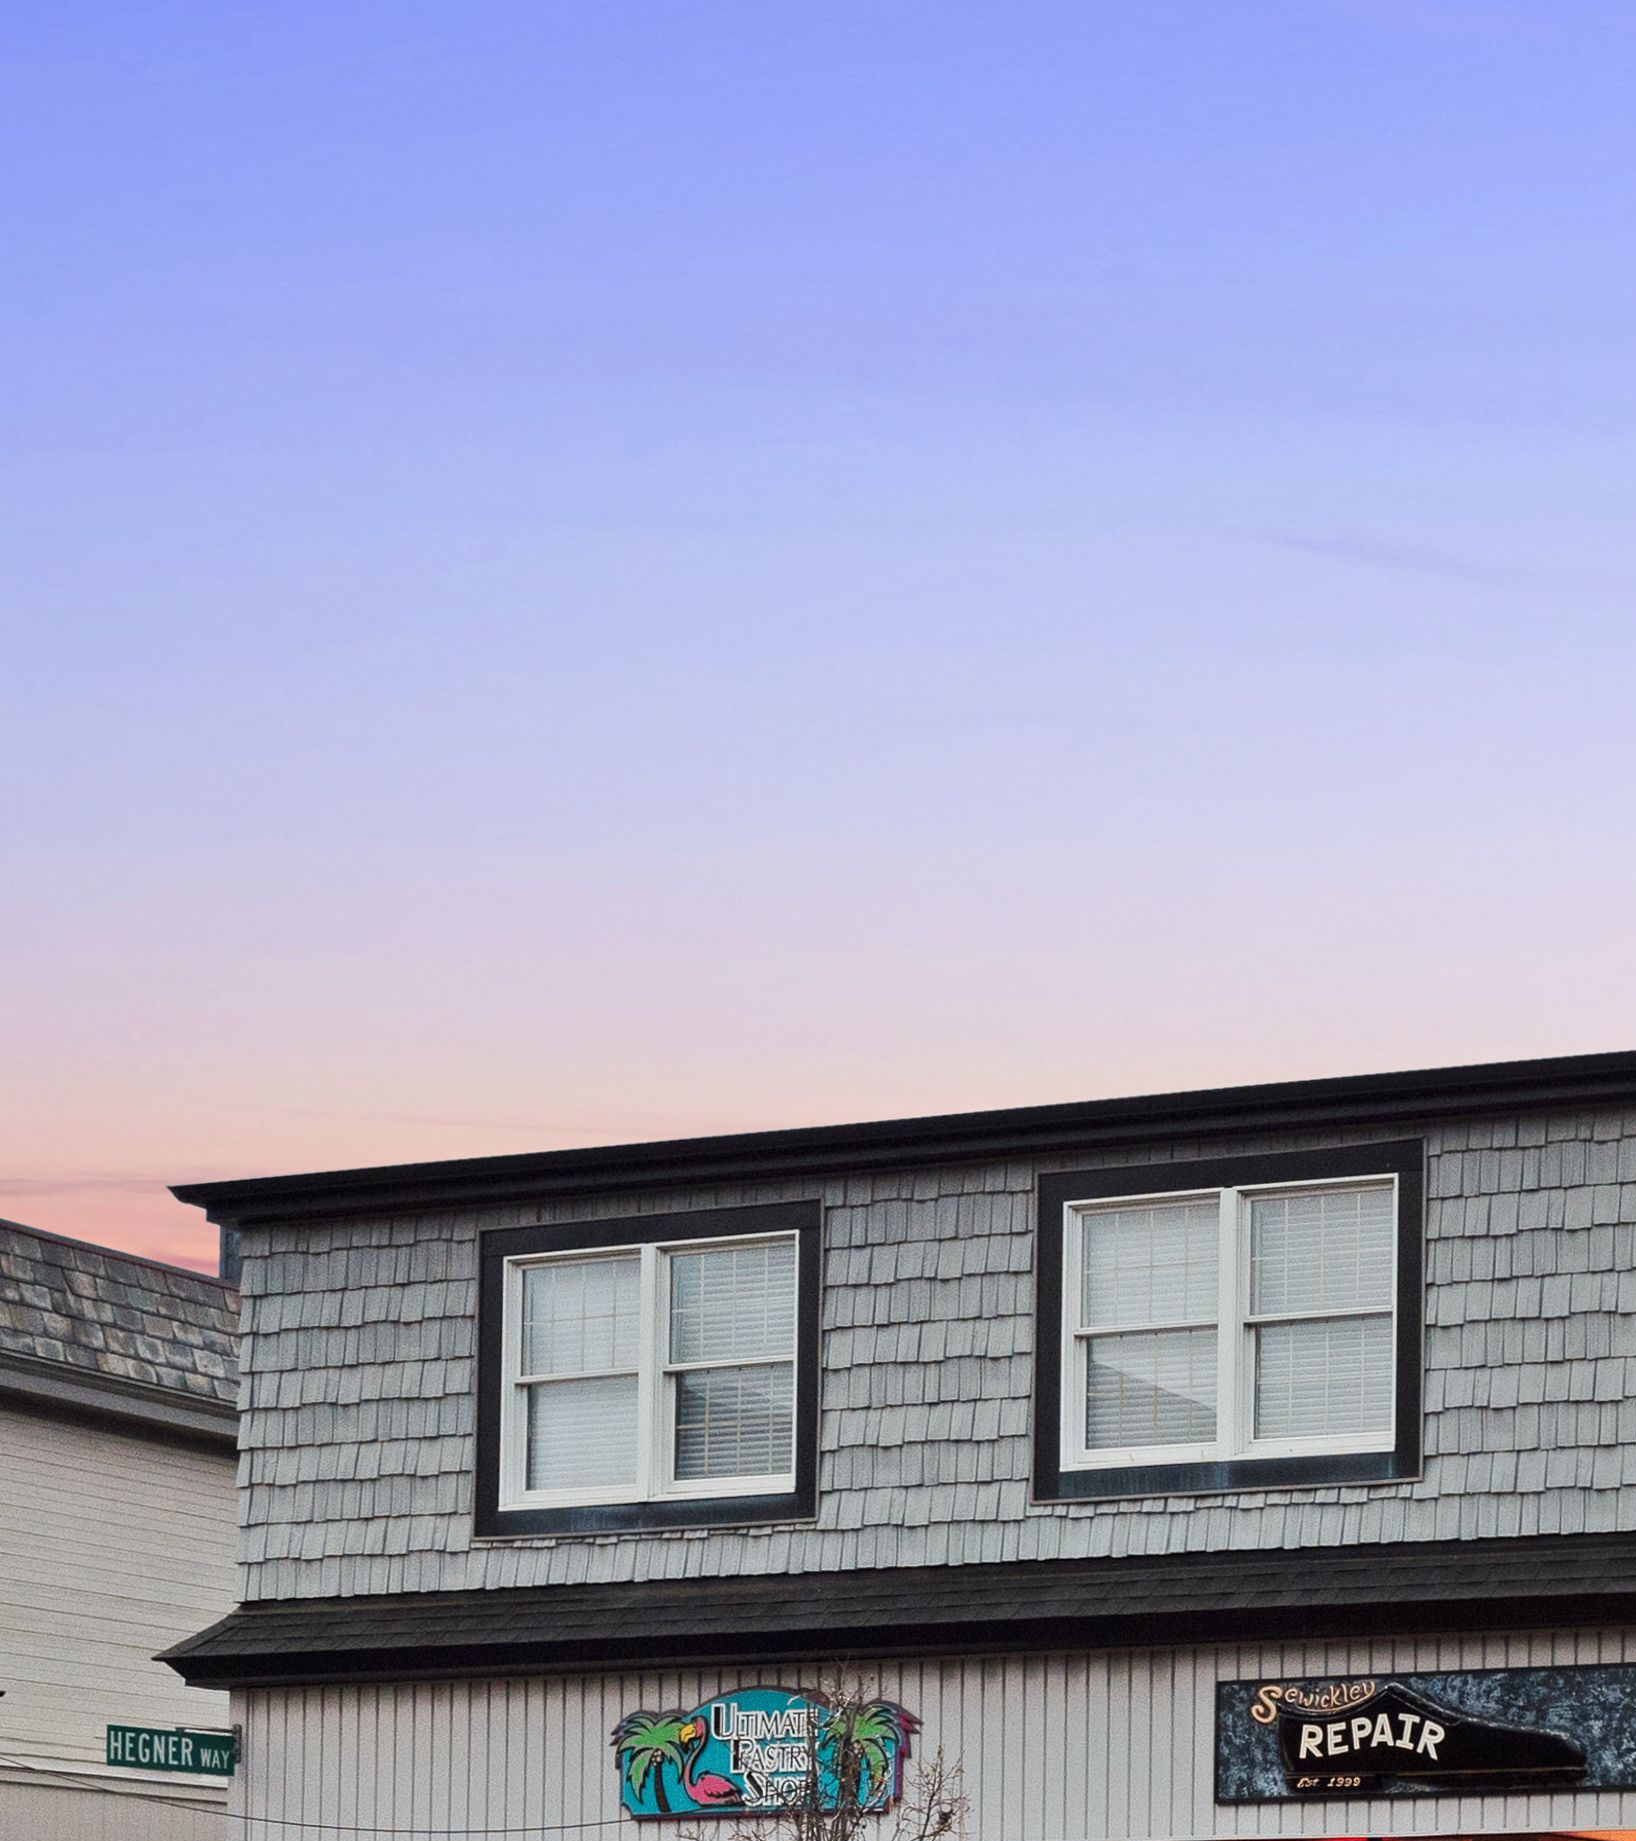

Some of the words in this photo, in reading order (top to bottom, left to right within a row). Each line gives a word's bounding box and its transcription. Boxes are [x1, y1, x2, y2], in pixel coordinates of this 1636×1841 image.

[1251, 1681, 1376, 1724] Sewickley
[110, 1731, 193, 1766] HEGNER
[200, 1748, 230, 1769] WAY
[1299, 1713, 1445, 1760] REPAIR
